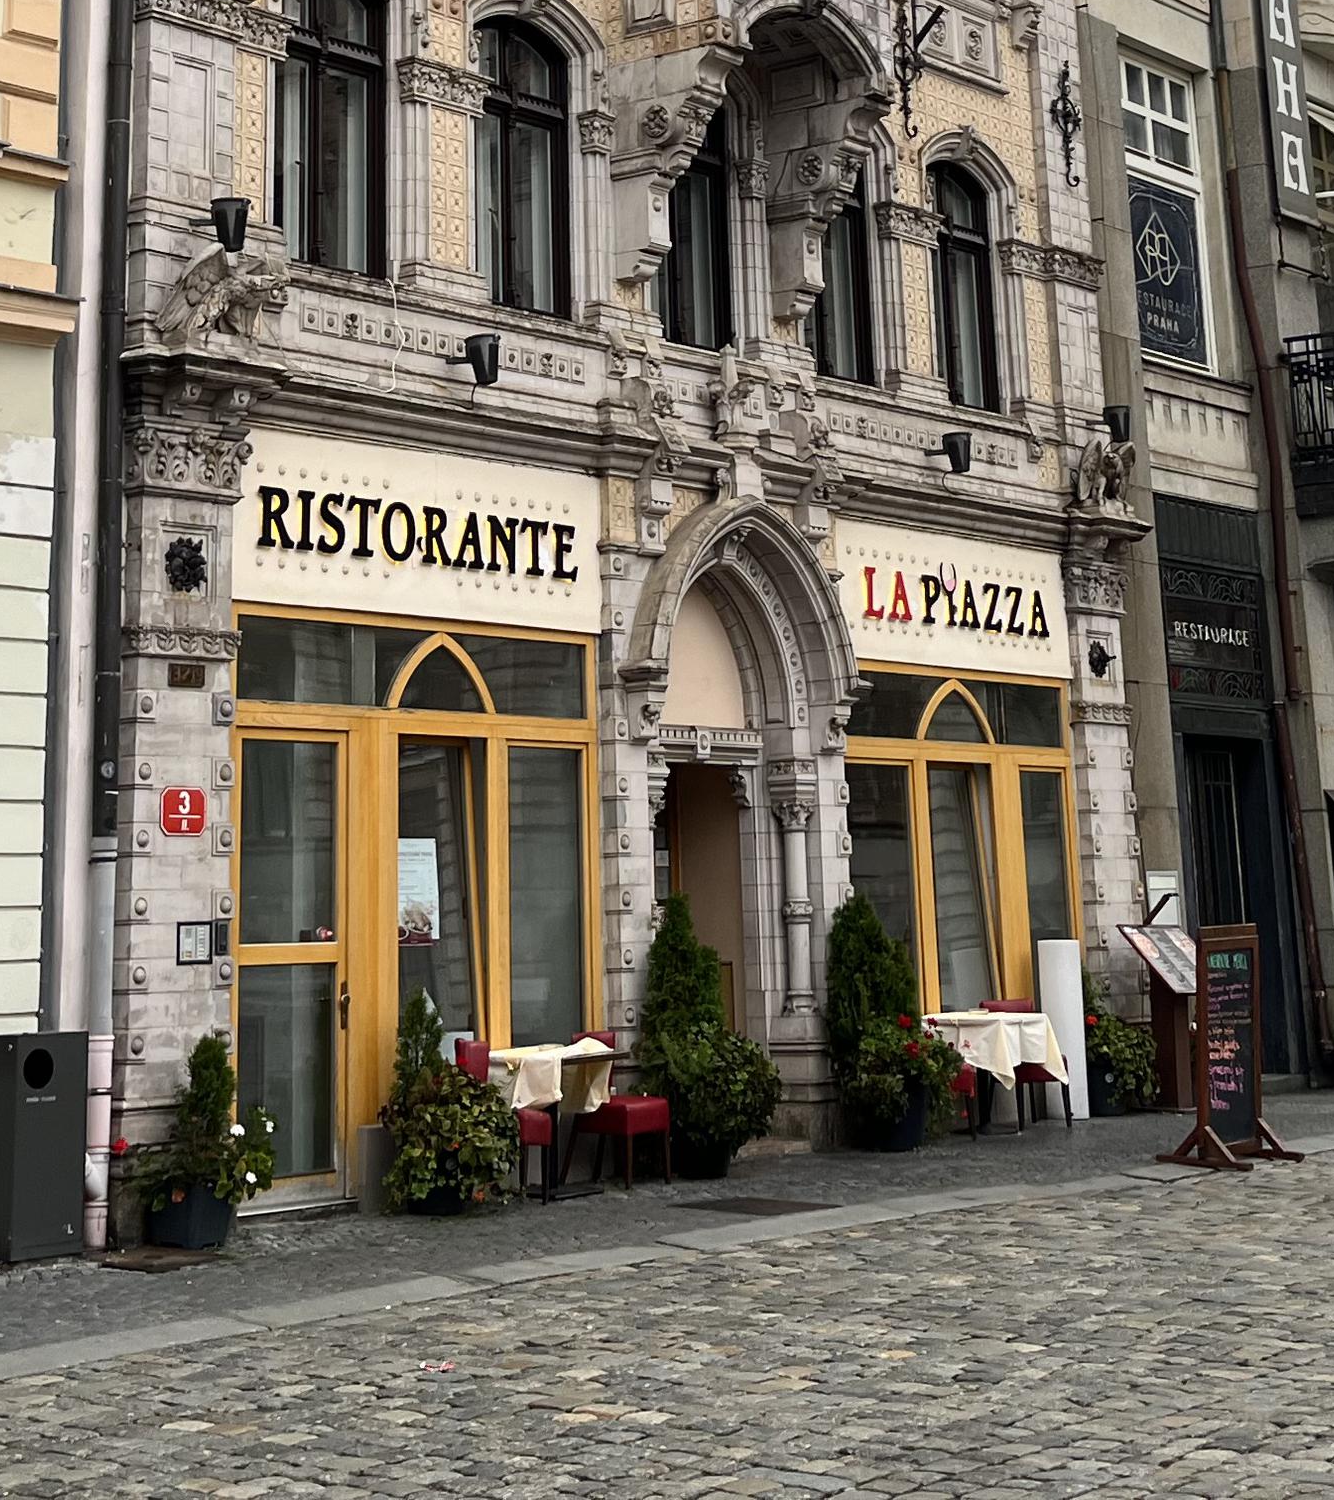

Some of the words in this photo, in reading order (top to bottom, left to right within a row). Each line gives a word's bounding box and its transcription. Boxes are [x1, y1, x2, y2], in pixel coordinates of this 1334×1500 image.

[1138, 290, 1193, 318] ESTAURACE
[1147, 311, 1179, 334] PRAHA
[258, 485, 579, 583] RISTORANTE
[863, 566, 913, 621] LA
[920, 562, 1050, 638] PIAZZA
[1173, 621, 1250, 648] RESTAURACE
[178, 790, 191, 815] 3
